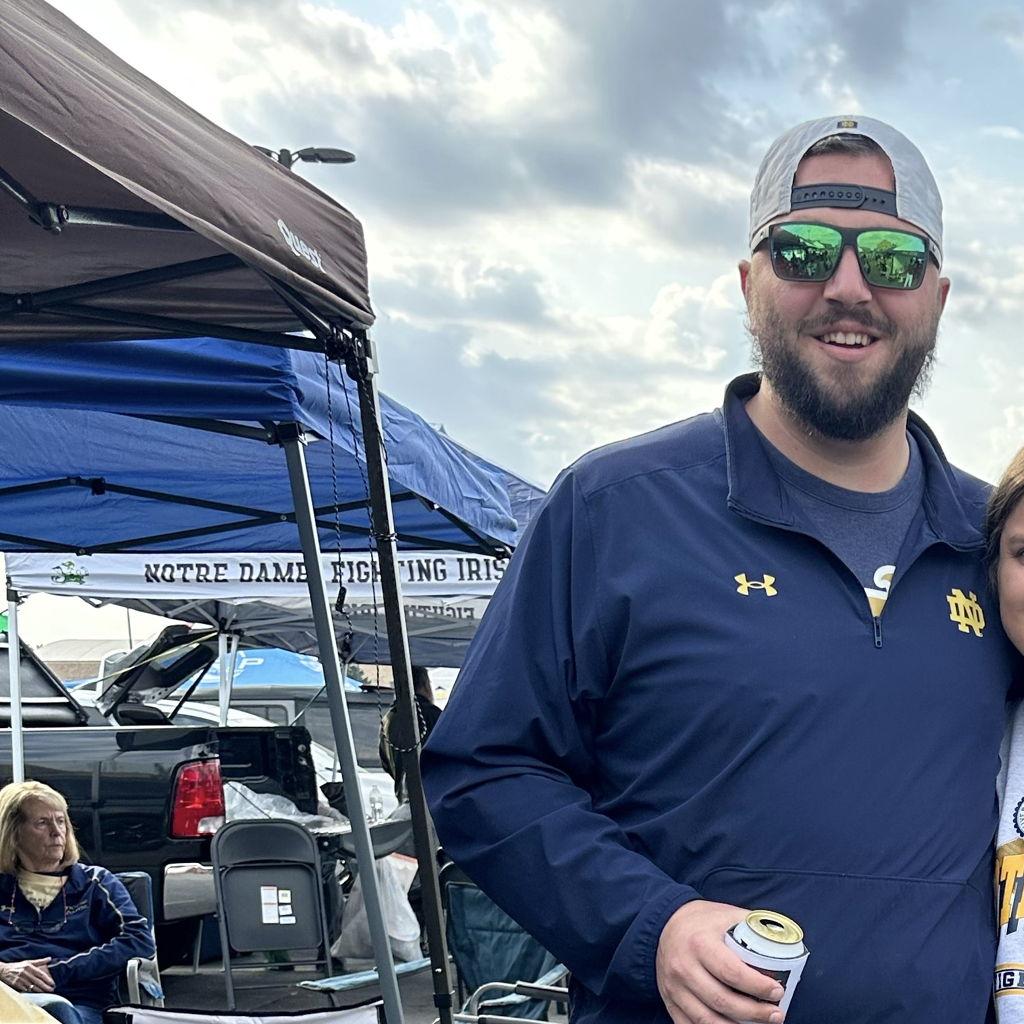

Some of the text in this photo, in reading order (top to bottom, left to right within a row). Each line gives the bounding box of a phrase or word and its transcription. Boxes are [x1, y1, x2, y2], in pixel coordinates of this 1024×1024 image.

[145, 562, 229, 583] NOTRE
[331, 558, 447, 582] FIGHING
[456, 557, 506, 581] IRIS
